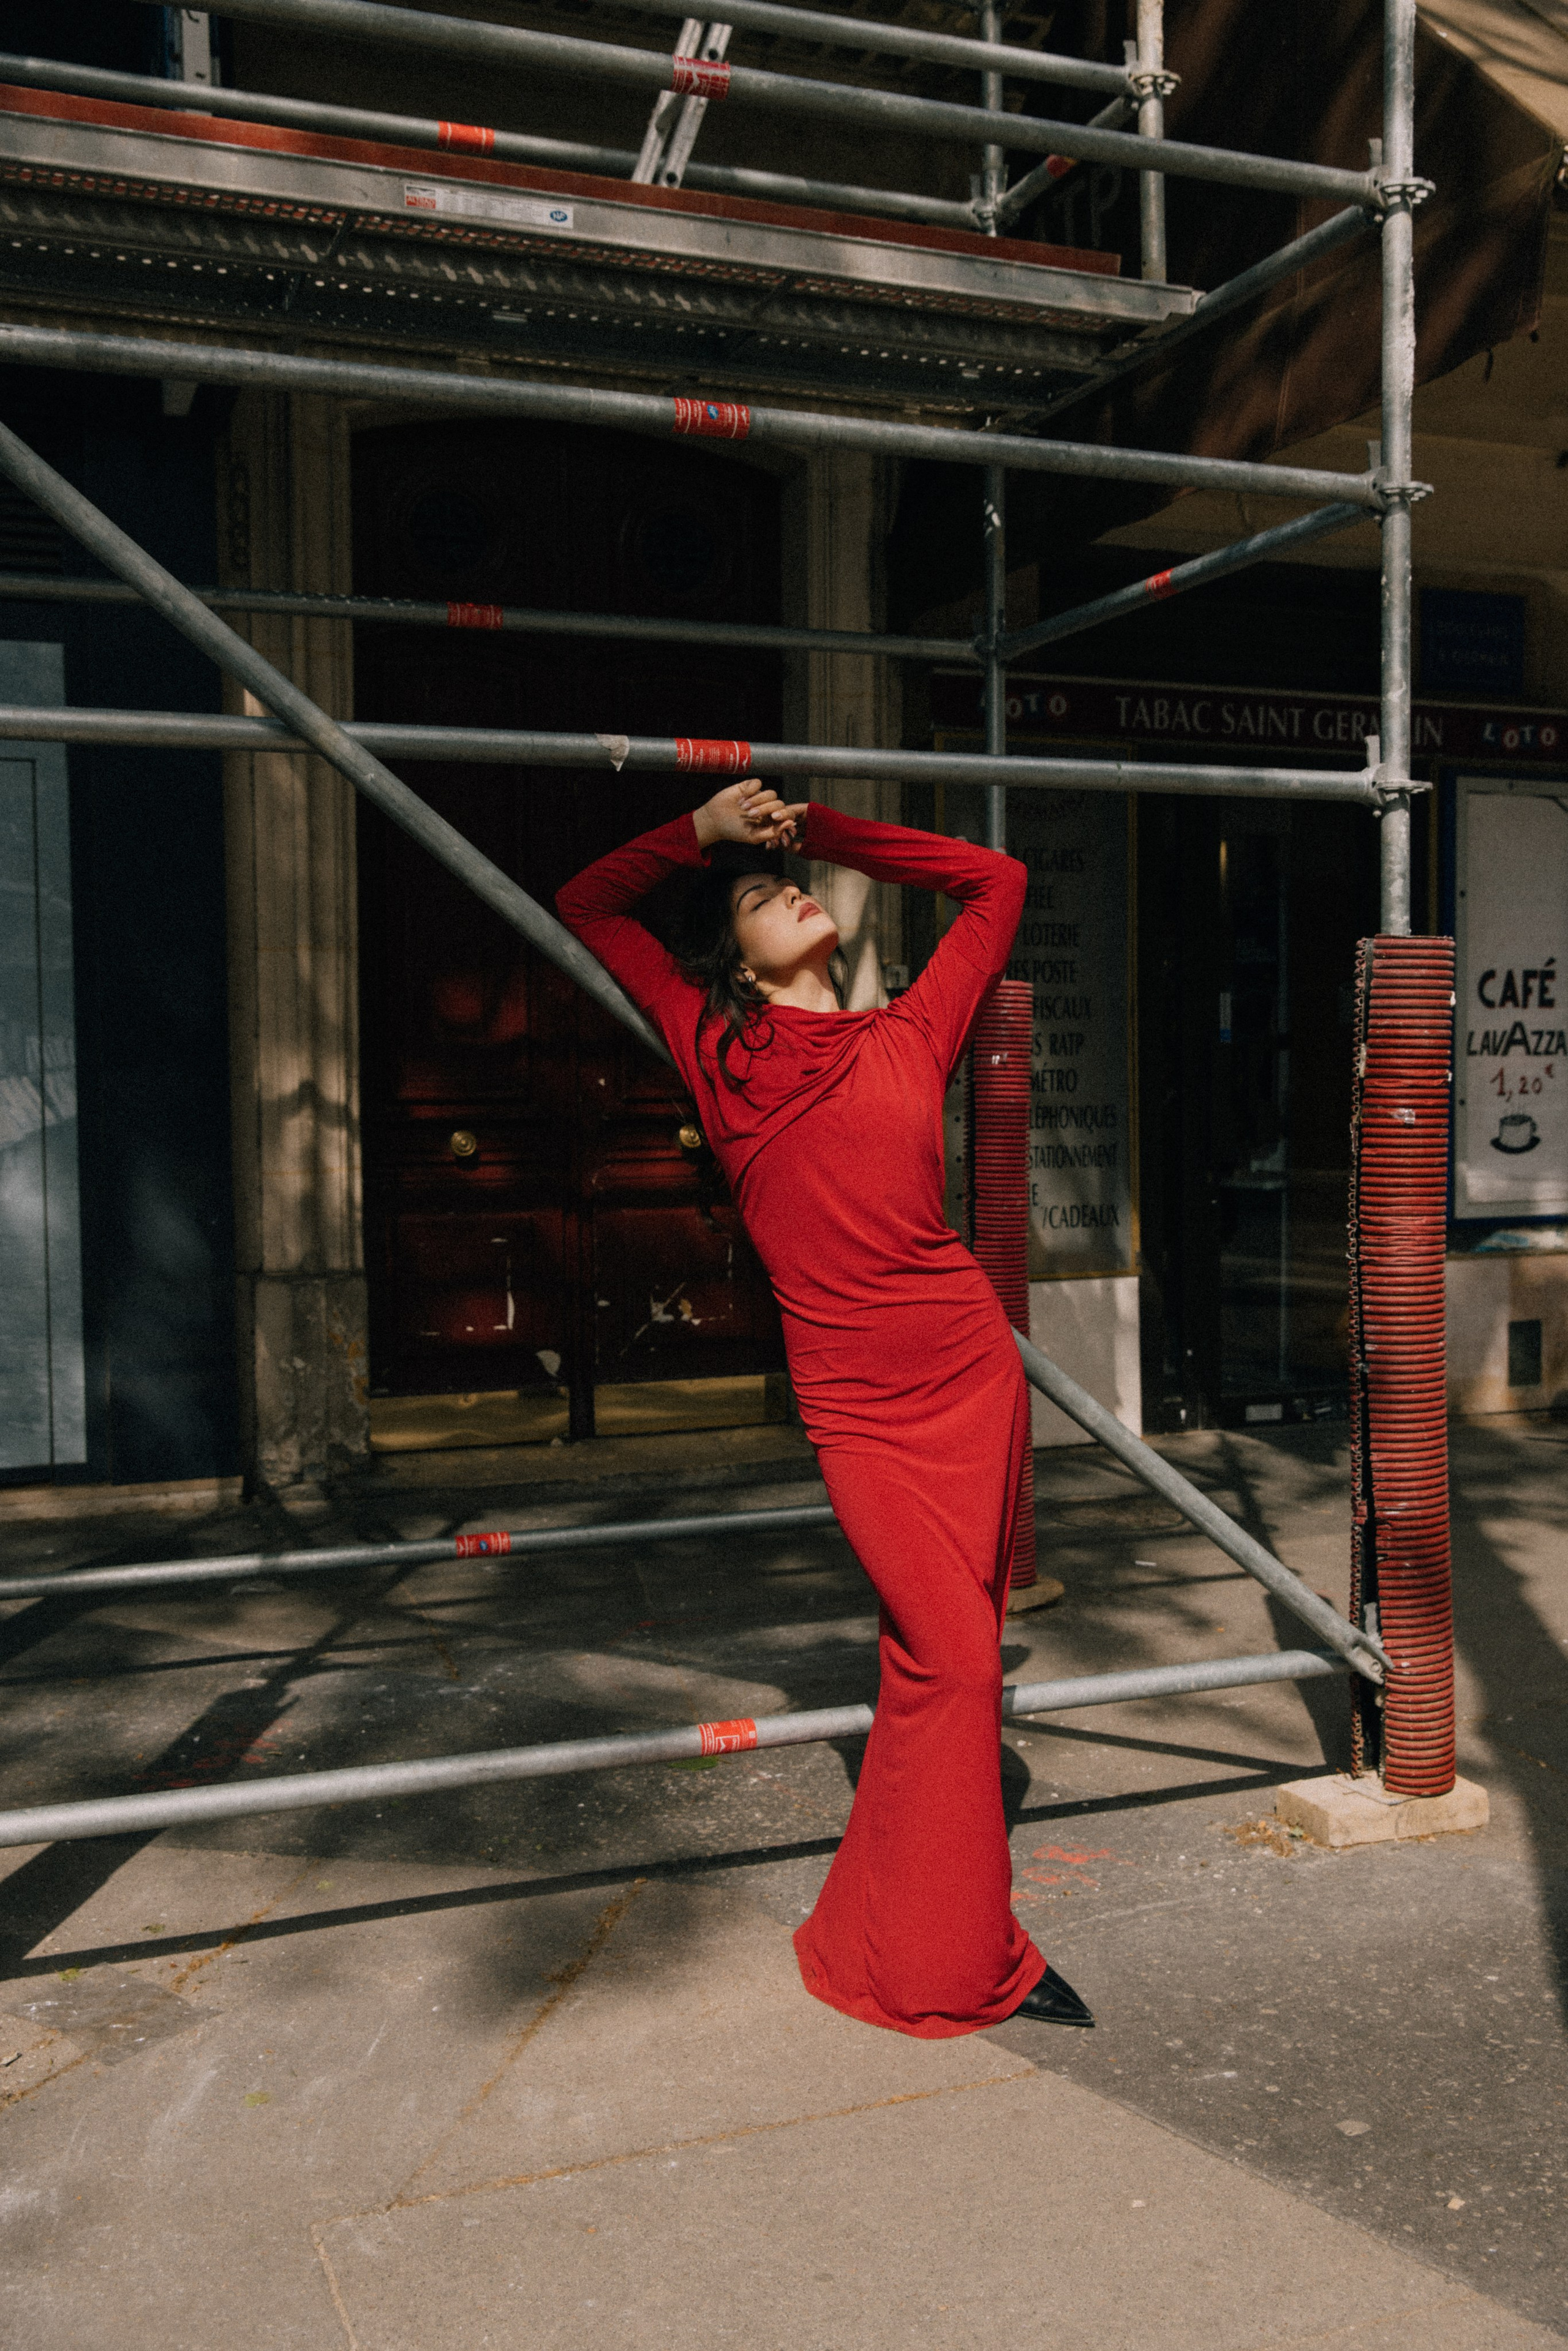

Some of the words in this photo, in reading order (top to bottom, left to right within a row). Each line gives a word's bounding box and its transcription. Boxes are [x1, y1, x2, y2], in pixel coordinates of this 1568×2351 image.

[981, 693, 1068, 719] OTO
[1115, 695, 1212, 733] TABAC
[1221, 703, 1305, 739] SAINT
[1313, 709, 1444, 747] GERIN
[1483, 722, 1557, 749] LOTO
[1022, 923, 1079, 947] LOTERIE
[1033, 959, 1078, 984] POSTE
[1477, 956, 1556, 1009] CAFÉ
[1033, 995, 1092, 1021] FISCAUX
[1049, 1032, 1084, 1056] RATP
[1466, 1021, 1567, 1057] LAVAZZA
[1030, 1100, 1118, 1134] LÉPHONIQUES
